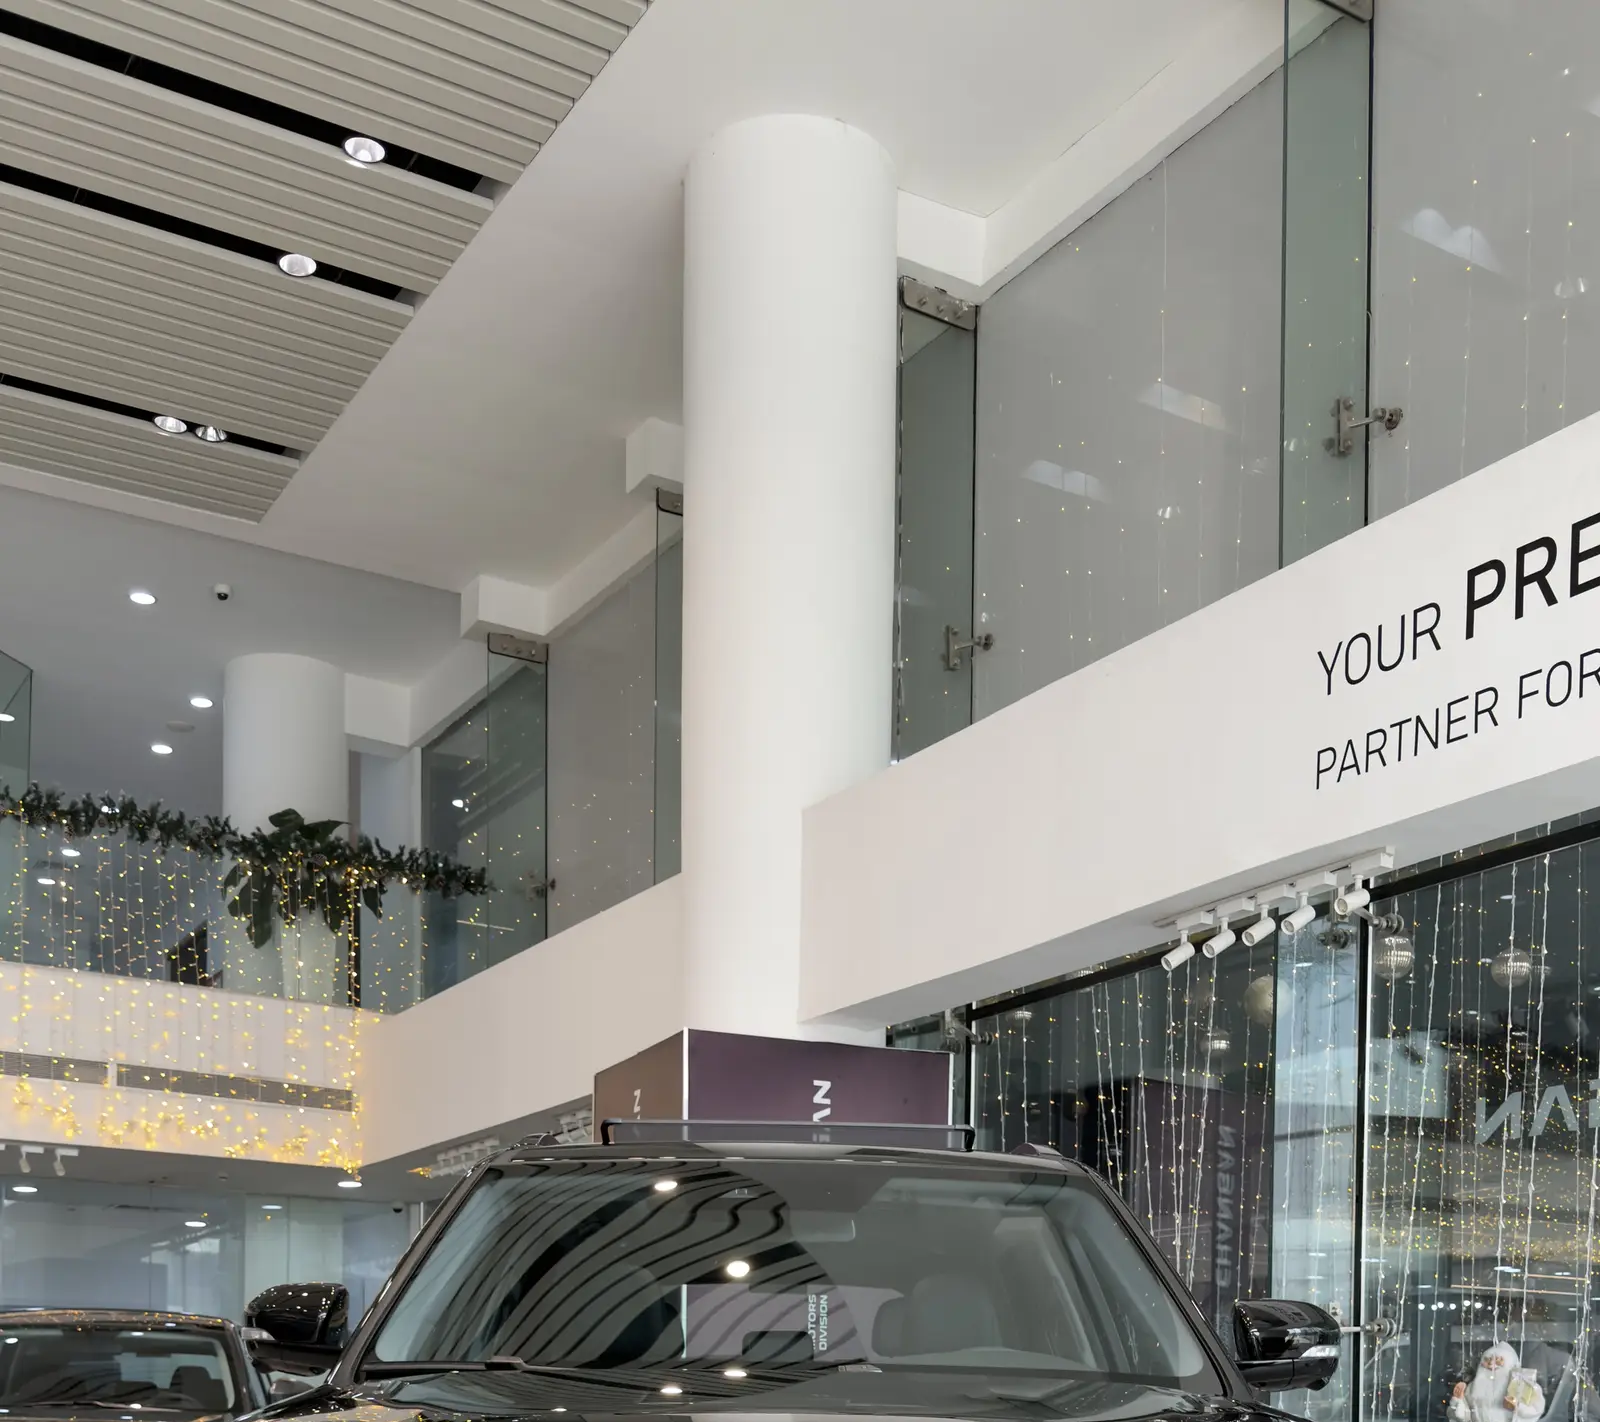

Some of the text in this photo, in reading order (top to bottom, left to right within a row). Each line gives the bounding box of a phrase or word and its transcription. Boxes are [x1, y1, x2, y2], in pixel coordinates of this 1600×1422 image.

[1317, 512, 1600, 696] YOUR PRE
[1316, 648, 1600, 790] PARTNER FOR
[807, 1294, 817, 1350] OTORS
[819, 1294, 828, 1351] DIVISION
